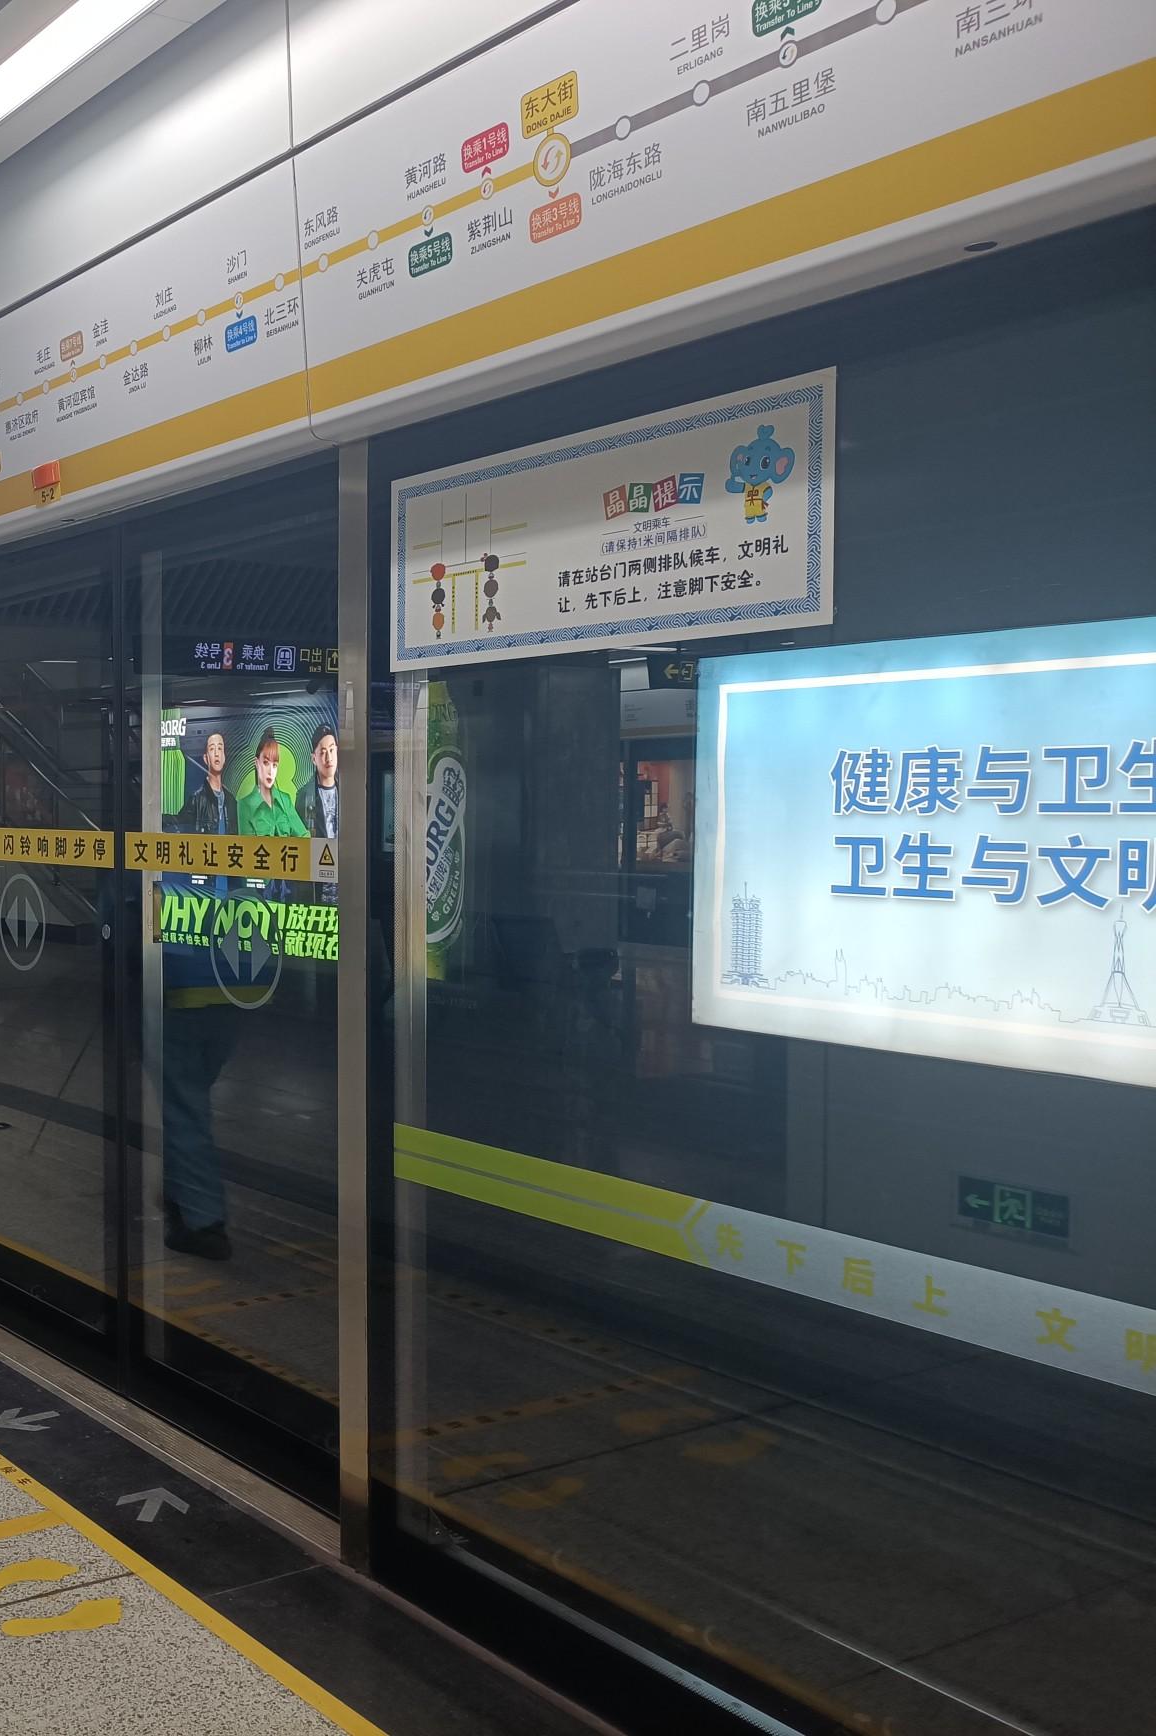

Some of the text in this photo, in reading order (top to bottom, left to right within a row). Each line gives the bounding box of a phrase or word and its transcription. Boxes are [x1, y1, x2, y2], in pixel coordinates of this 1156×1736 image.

[756, 14, 785, 33] Transfer
[786, 8, 796, 18] To
[797, 0, 813, 14] Line
[669, 13, 730, 61] 二里岗
[954, 12, 1044, 58] NANSANHUAN
[676, 46, 724, 76] ERLIGANG
[524, 78, 574, 120] 东大街
[746, 67, 837, 127] 南五里堡
[526, 105, 572, 134] DONG DAJIE
[757, 103, 826, 139] NANWULIBAO
[462, 127, 508, 162] 换乘1号线
[404, 152, 447, 190] 黄河路
[464, 155, 485, 170] Transfer
[485, 152, 492, 160] To
[589, 142, 662, 192] 陇海东路
[406, 177, 447, 201] HUANGHELU
[591, 169, 663, 206] LONGHAIDONGLU
[304, 205, 339, 238] 东风路
[467, 206, 513, 243] 紫荆山
[531, 197, 580, 232] 换乘3号线
[304, 227, 341, 250] DONGFENGLU
[470, 232, 511, 255] ZIJINGSHAN
[532, 226, 554, 241] Transfer
[226, 249, 247, 274] 沙门
[410, 236, 451, 267] 换乘5号线
[227, 270, 248, 285] SHAMEN
[356, 257, 395, 289] 关虎屯
[154, 286, 174, 308] 刘庄
[358, 280, 395, 301] GUANHUTUN
[264, 296, 300, 326] 北三环
[193, 334, 214, 357] 柳林
[122, 362, 149, 387] 金达路
[57, 385, 96, 414] 黄河迎宾馆
[41, 487, 55, 503] 5-2
[606, 476, 703, 518] 晶晶提示
[633, 516, 671, 534] 文明乘车
[133, 838, 300, 872] 文明礼让安全行
[715, 1222, 950, 1317] 先下后上
